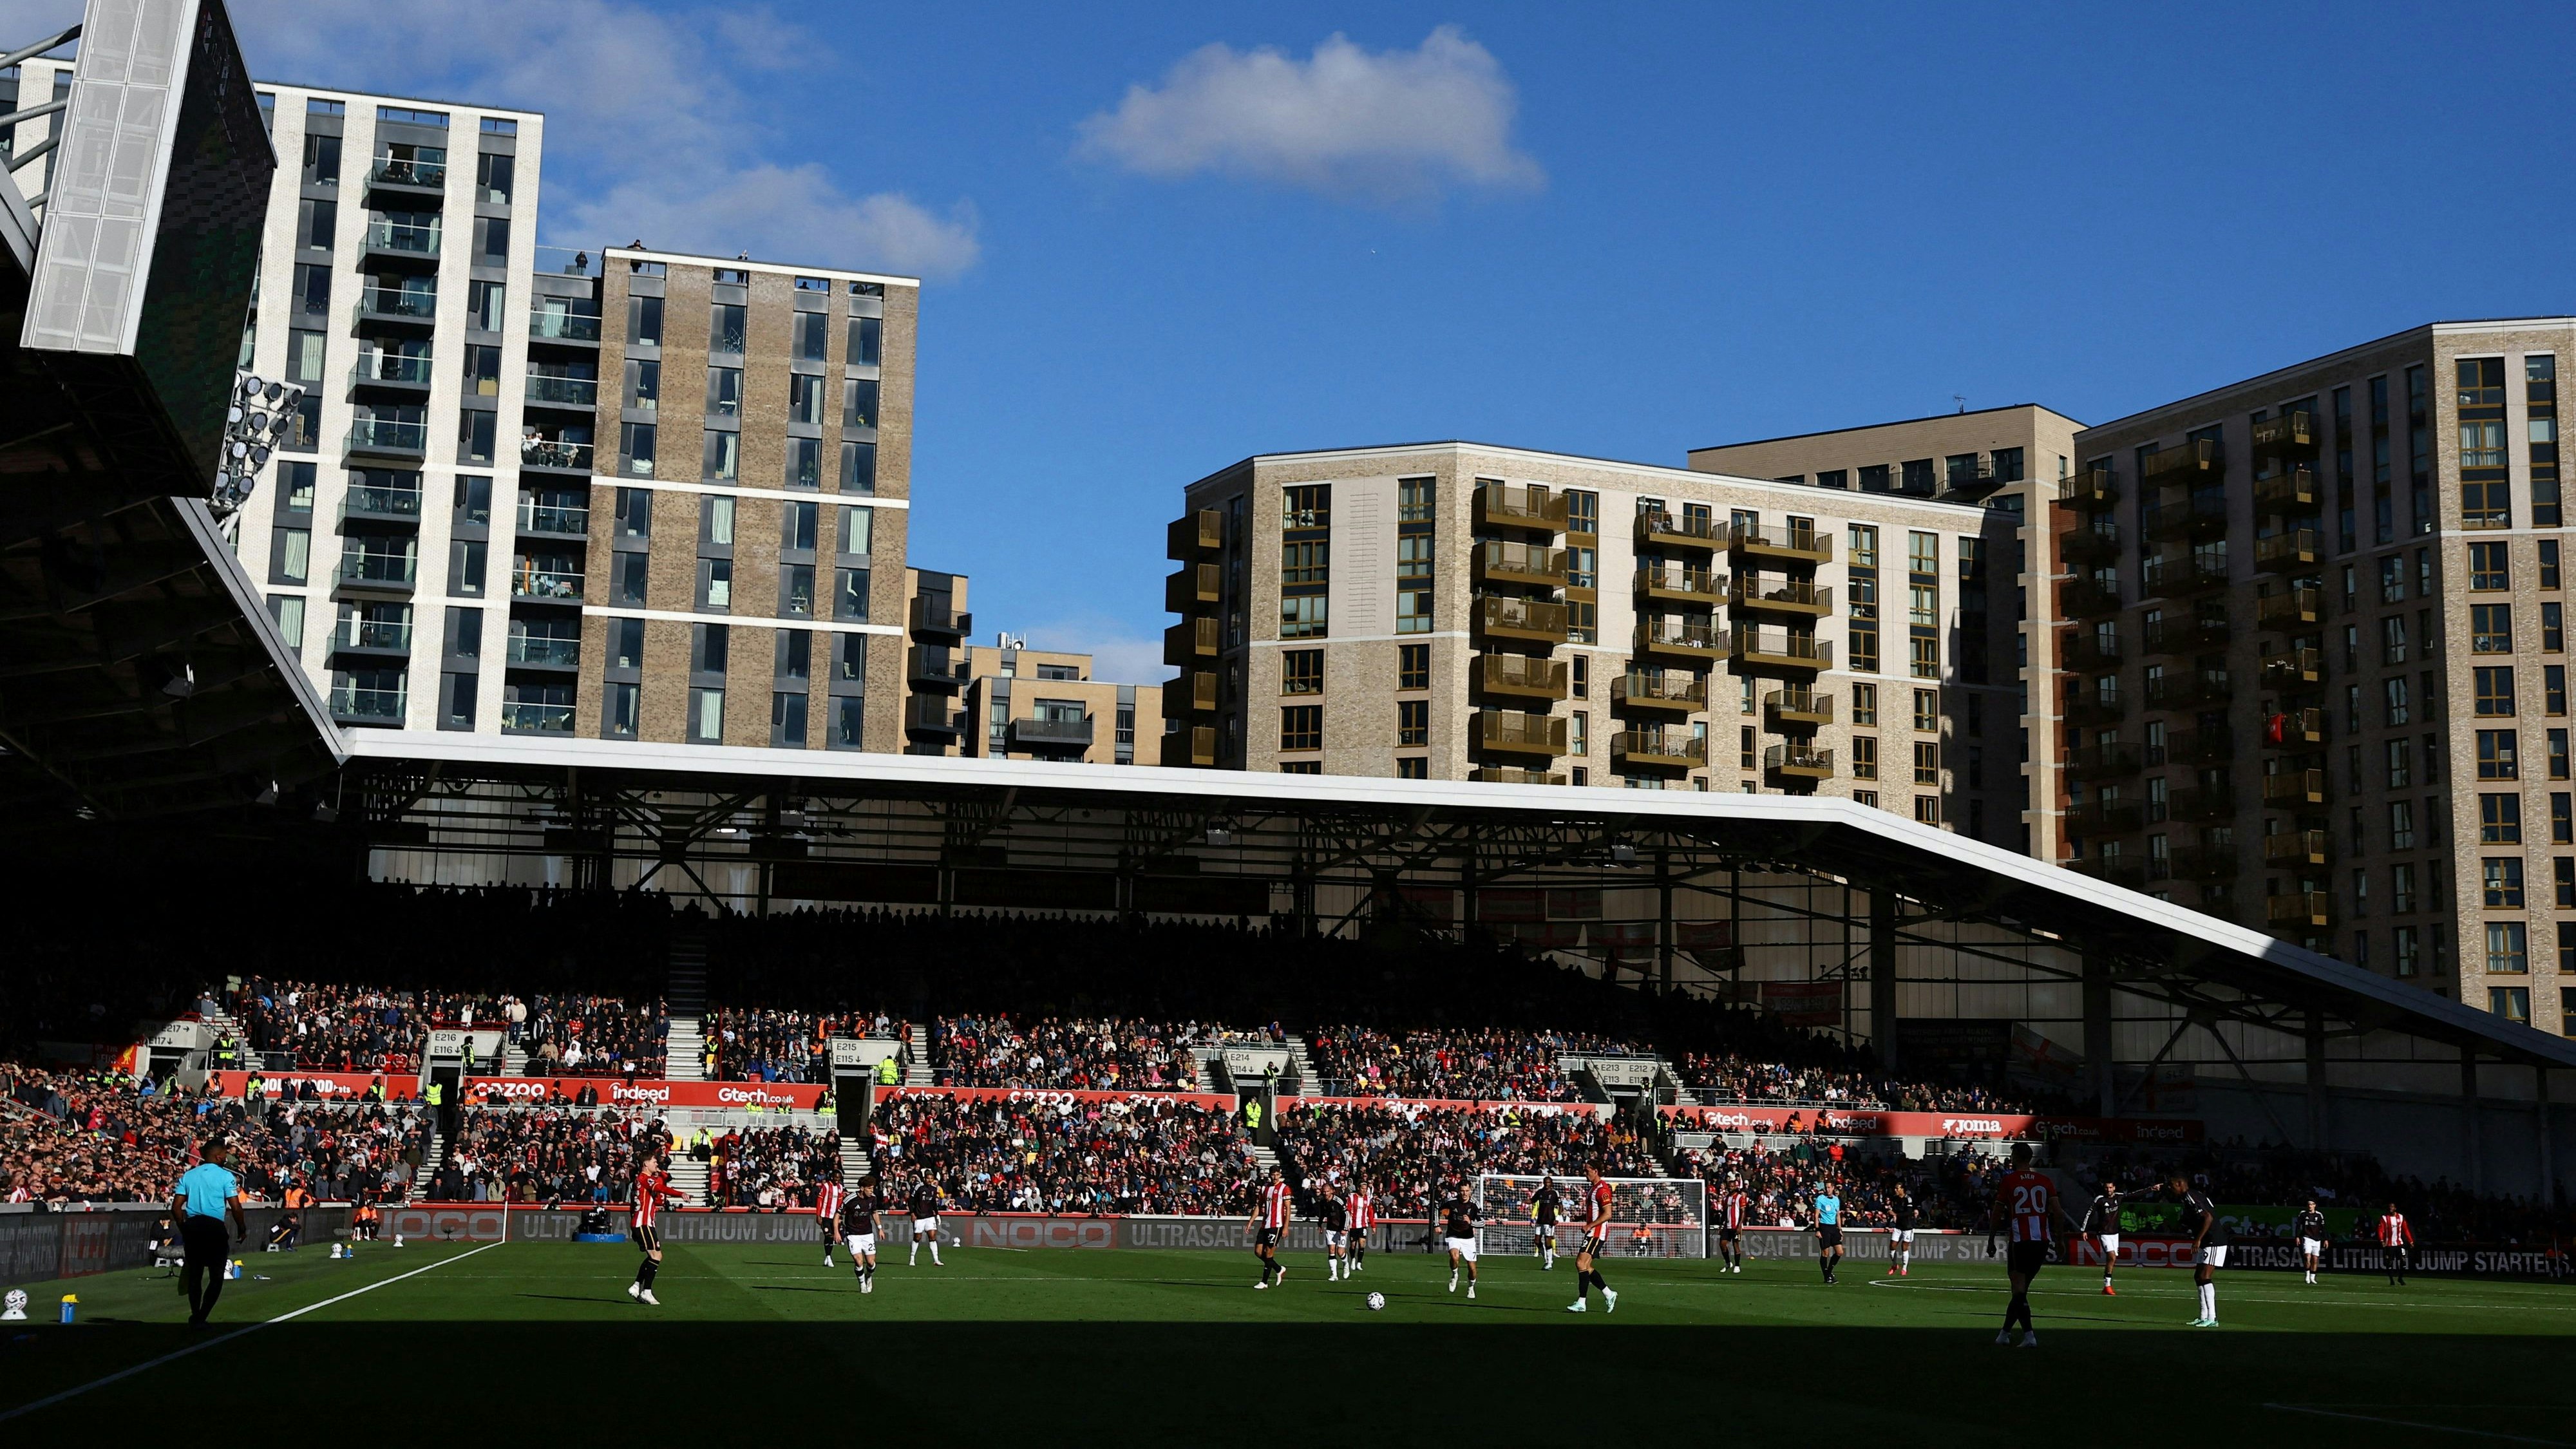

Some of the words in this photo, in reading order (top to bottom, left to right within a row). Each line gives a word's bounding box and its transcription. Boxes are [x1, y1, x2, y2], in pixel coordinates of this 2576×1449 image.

[435, 1033, 457, 1041] E216
[837, 1043, 857, 1051] E215
[836, 1055, 853, 1063] E115
[612, 1084, 670, 1101] indeed
[2013, 1184, 2047, 1215] 20
[664, 1217, 758, 1242] LITHIUM
[972, 1219, 1113, 1248] NOCO
[1131, 1224, 1256, 1248] ULTRASAFE
[2415, 1249, 2468, 1272] JUMP
